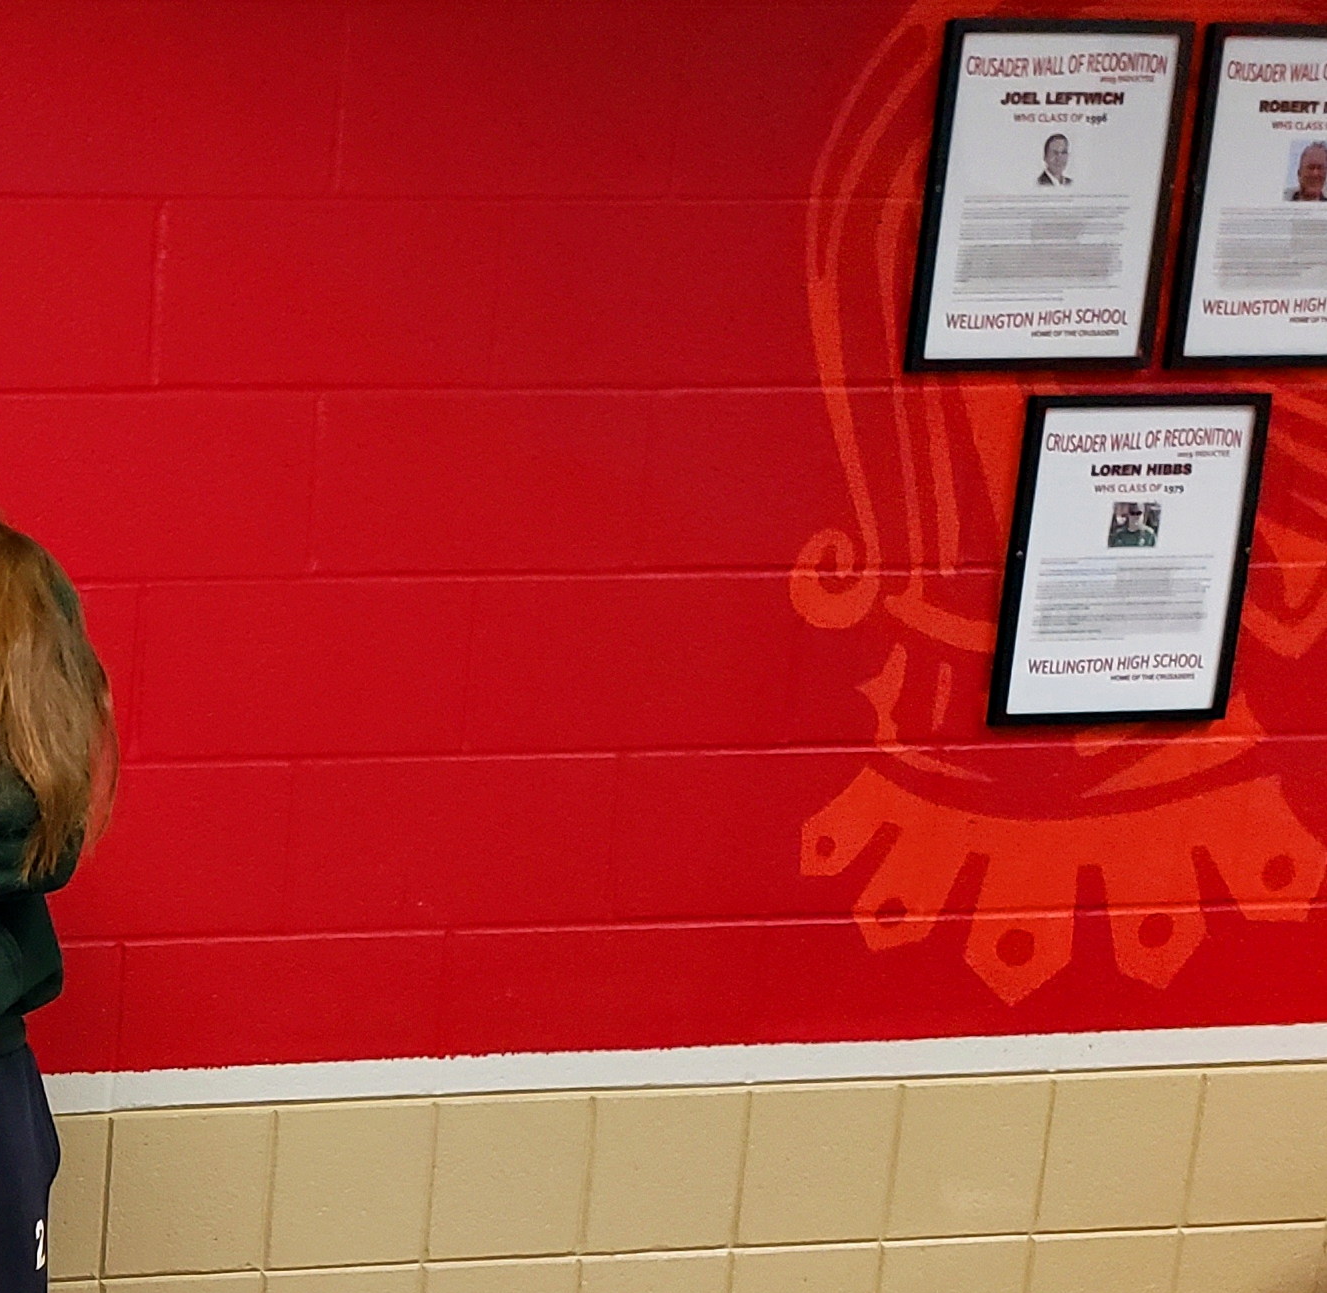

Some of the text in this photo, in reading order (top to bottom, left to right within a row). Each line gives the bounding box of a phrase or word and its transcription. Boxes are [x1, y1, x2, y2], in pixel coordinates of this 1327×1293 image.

[966, 52, 1169, 77] CRUSADER WALL OF RECOGNITION
[1227, 60, 1287, 82] CRUSADER
[1290, 62, 1319, 83] WALL
[1001, 91, 1124, 105] JOEL LEFTWICH
[1259, 99, 1320, 113] ROBERT
[1038, 113, 1068, 123] CLASS
[1071, 113, 1084, 122] OF
[1295, 121, 1324, 131] CLASS
[1202, 298, 1290, 316] WELLINGTON
[946, 308, 1128, 330] WELLINGTON HIGH SCHOOL
[1046, 427, 1243, 453] CRUSADER WALL OF RECOGNITION
[1090, 463, 1192, 477] LOREN HIBBS
[1117, 484, 1146, 493] CLASS
[1149, 483, 1162, 492] OF
[1028, 653, 1204, 675] WELLINGTON HIGH SCHOOL
